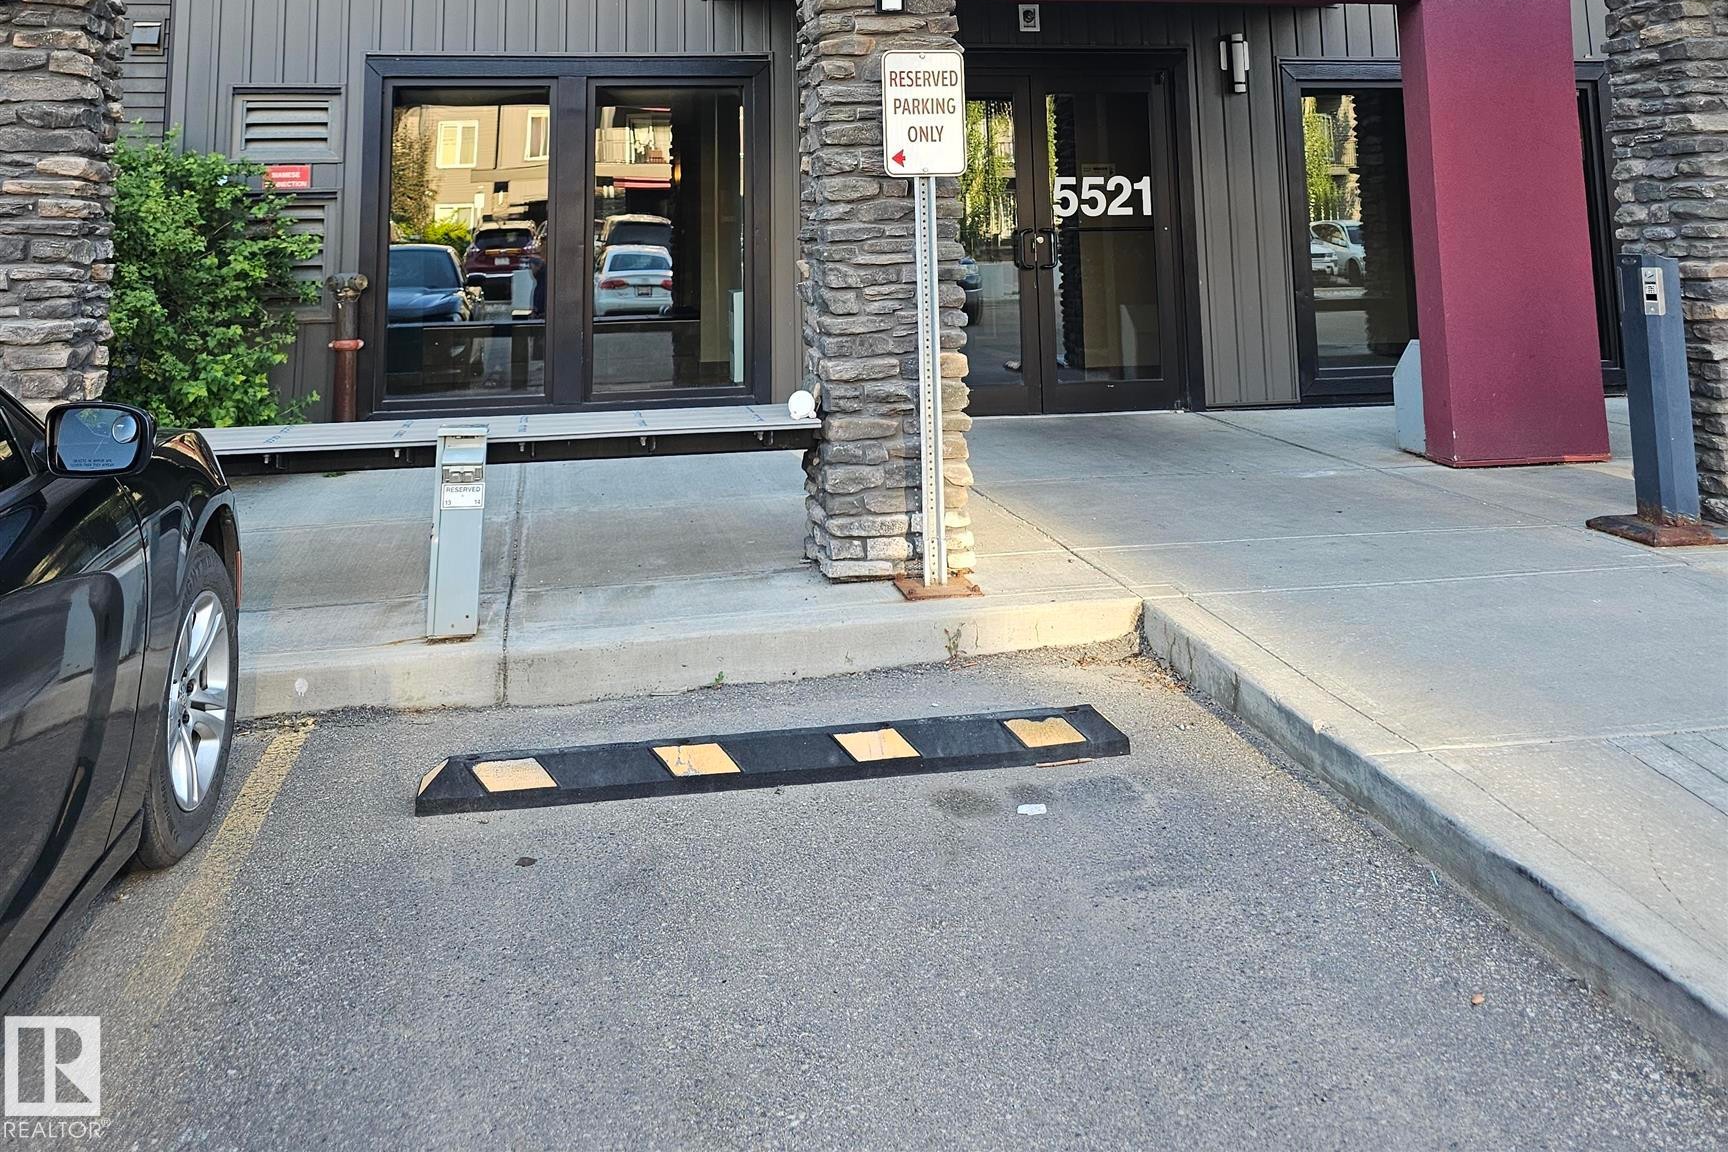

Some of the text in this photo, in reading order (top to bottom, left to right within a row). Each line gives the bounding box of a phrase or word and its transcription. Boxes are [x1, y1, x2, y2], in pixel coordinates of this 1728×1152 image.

[889, 70, 958, 87] RESERVED
[893, 98, 956, 115] PARKING
[907, 125, 944, 143] ONLY
[1052, 175, 1152, 217] 5521
